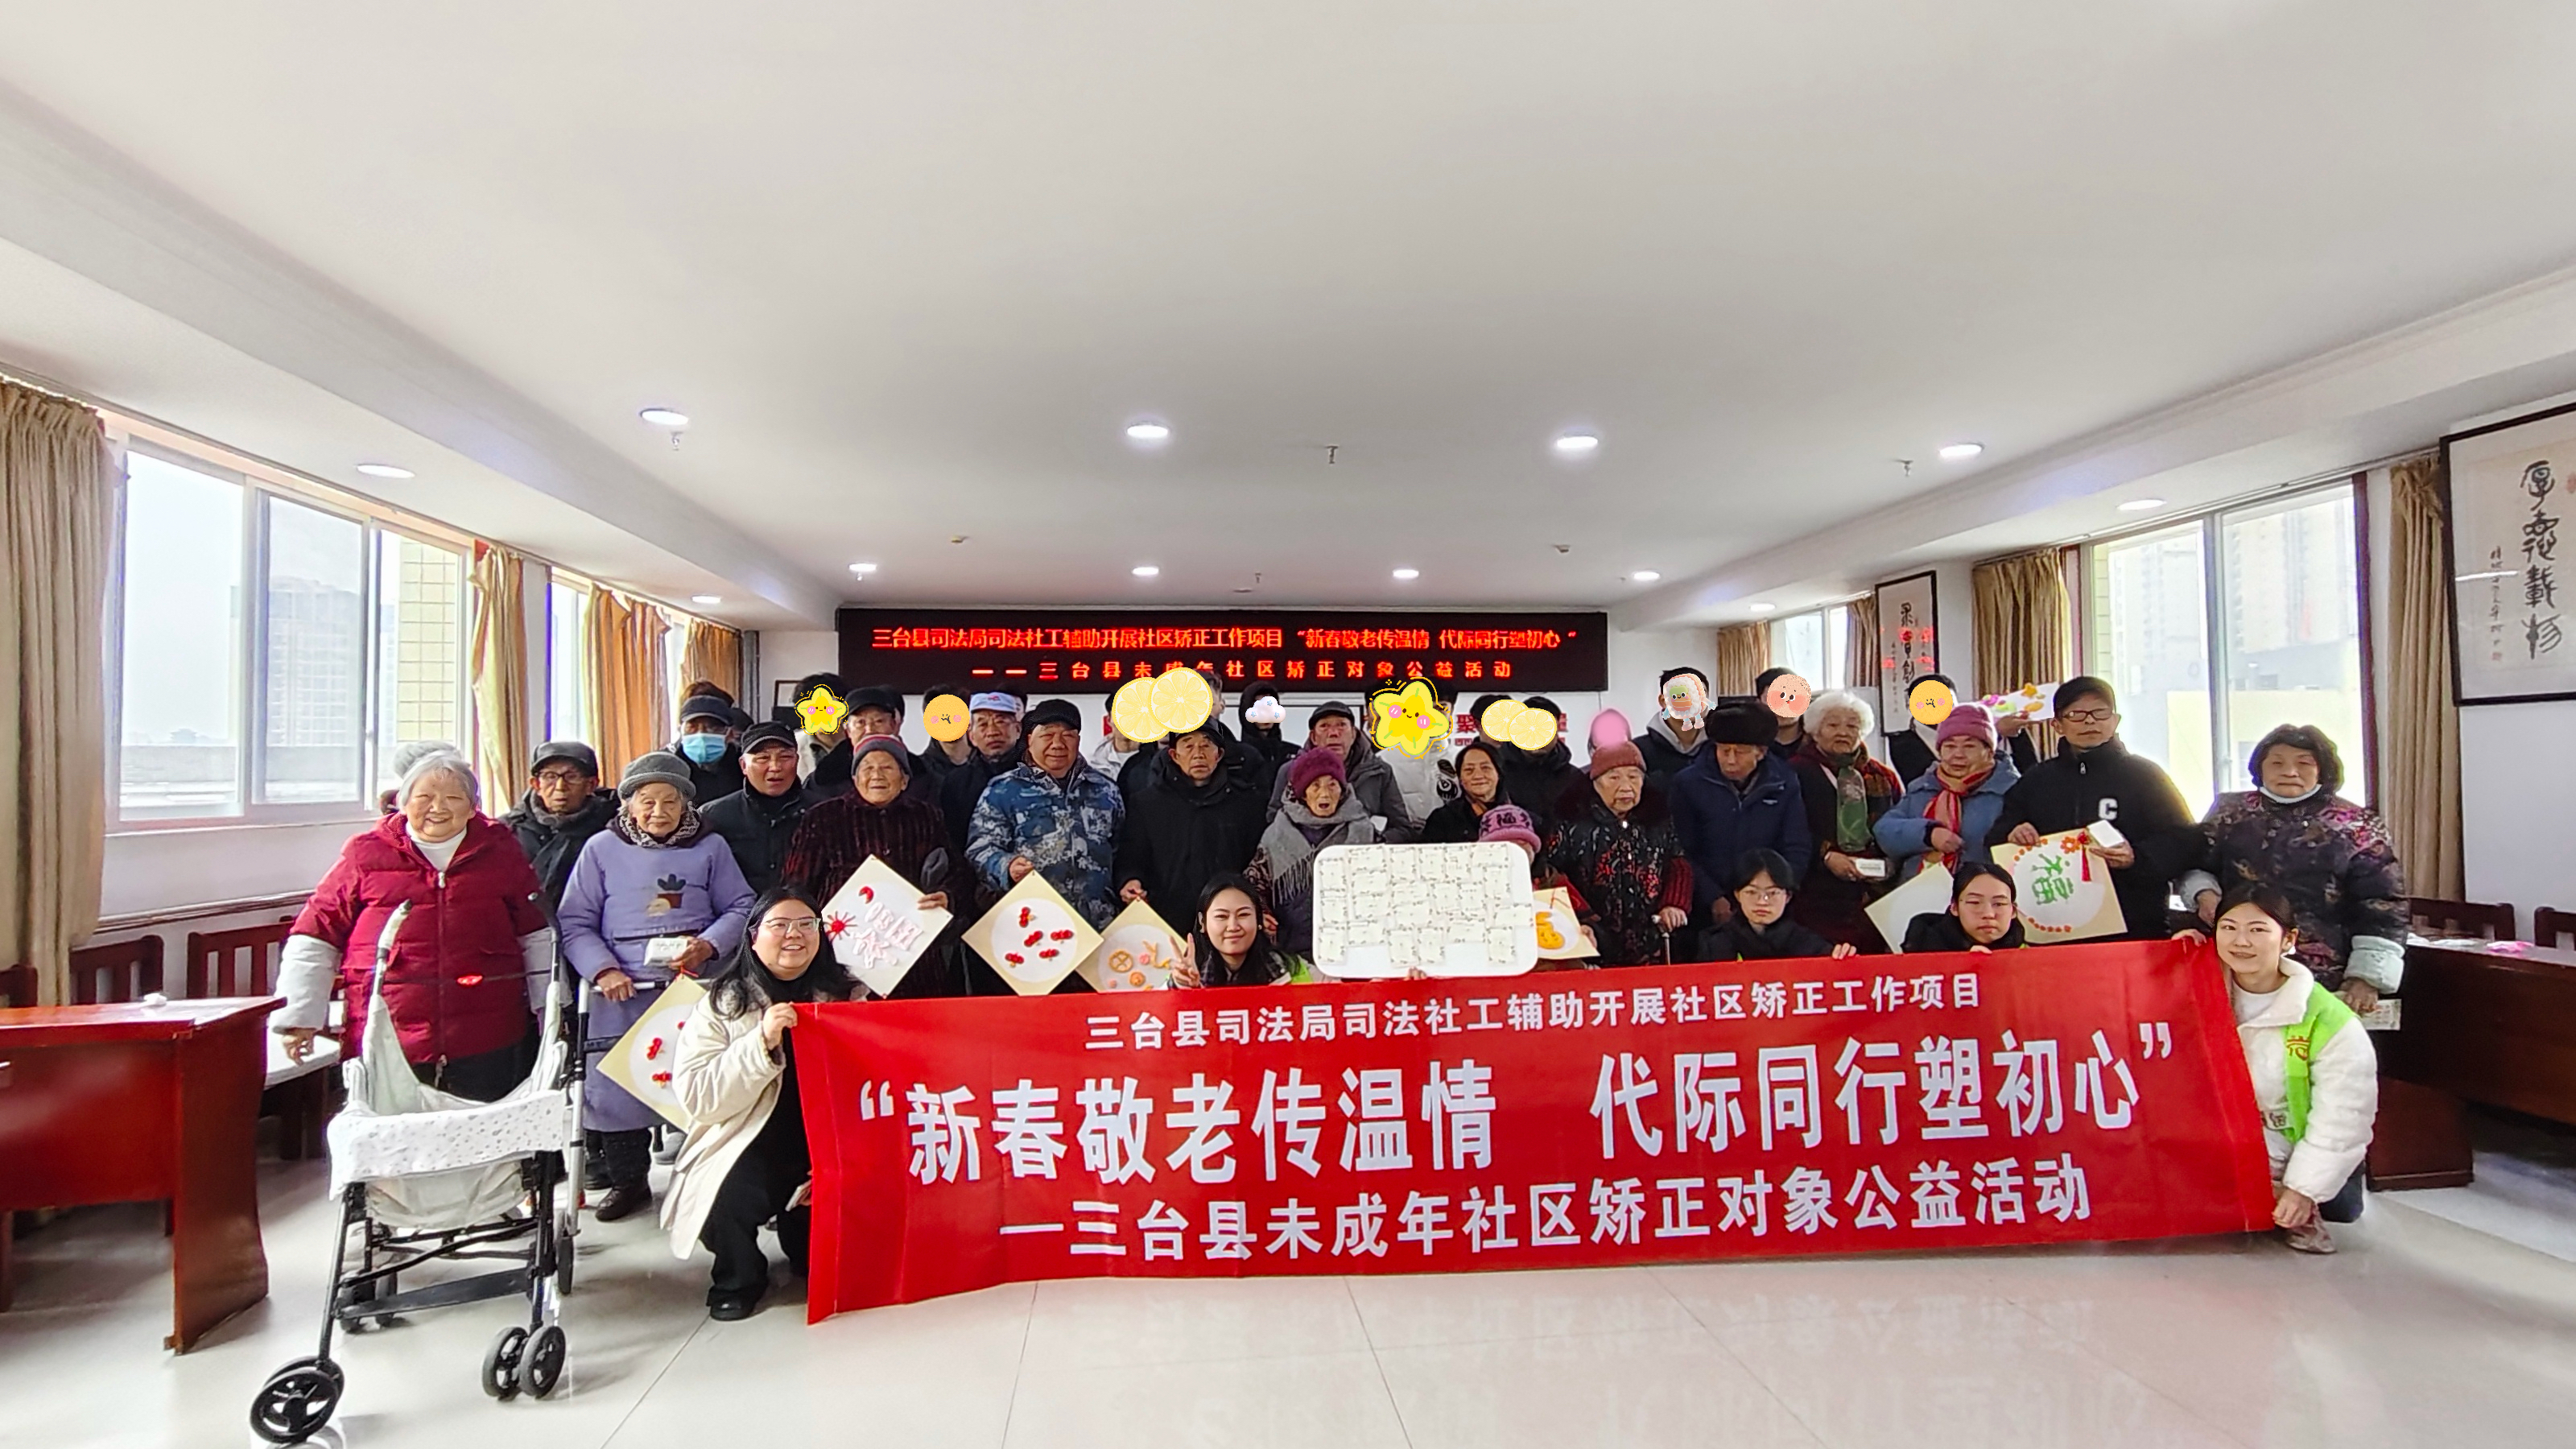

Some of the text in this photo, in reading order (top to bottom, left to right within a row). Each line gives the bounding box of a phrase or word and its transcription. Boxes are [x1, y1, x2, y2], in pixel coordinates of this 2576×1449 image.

[872, 627, 1282, 650] 三台县司法局司法社工辅助开展社区矫正工作项目
[2098, 798, 2118, 819] C
[1084, 972, 1980, 1050] 三台县司法局司法社工辅助开展社区矫正工作项目
